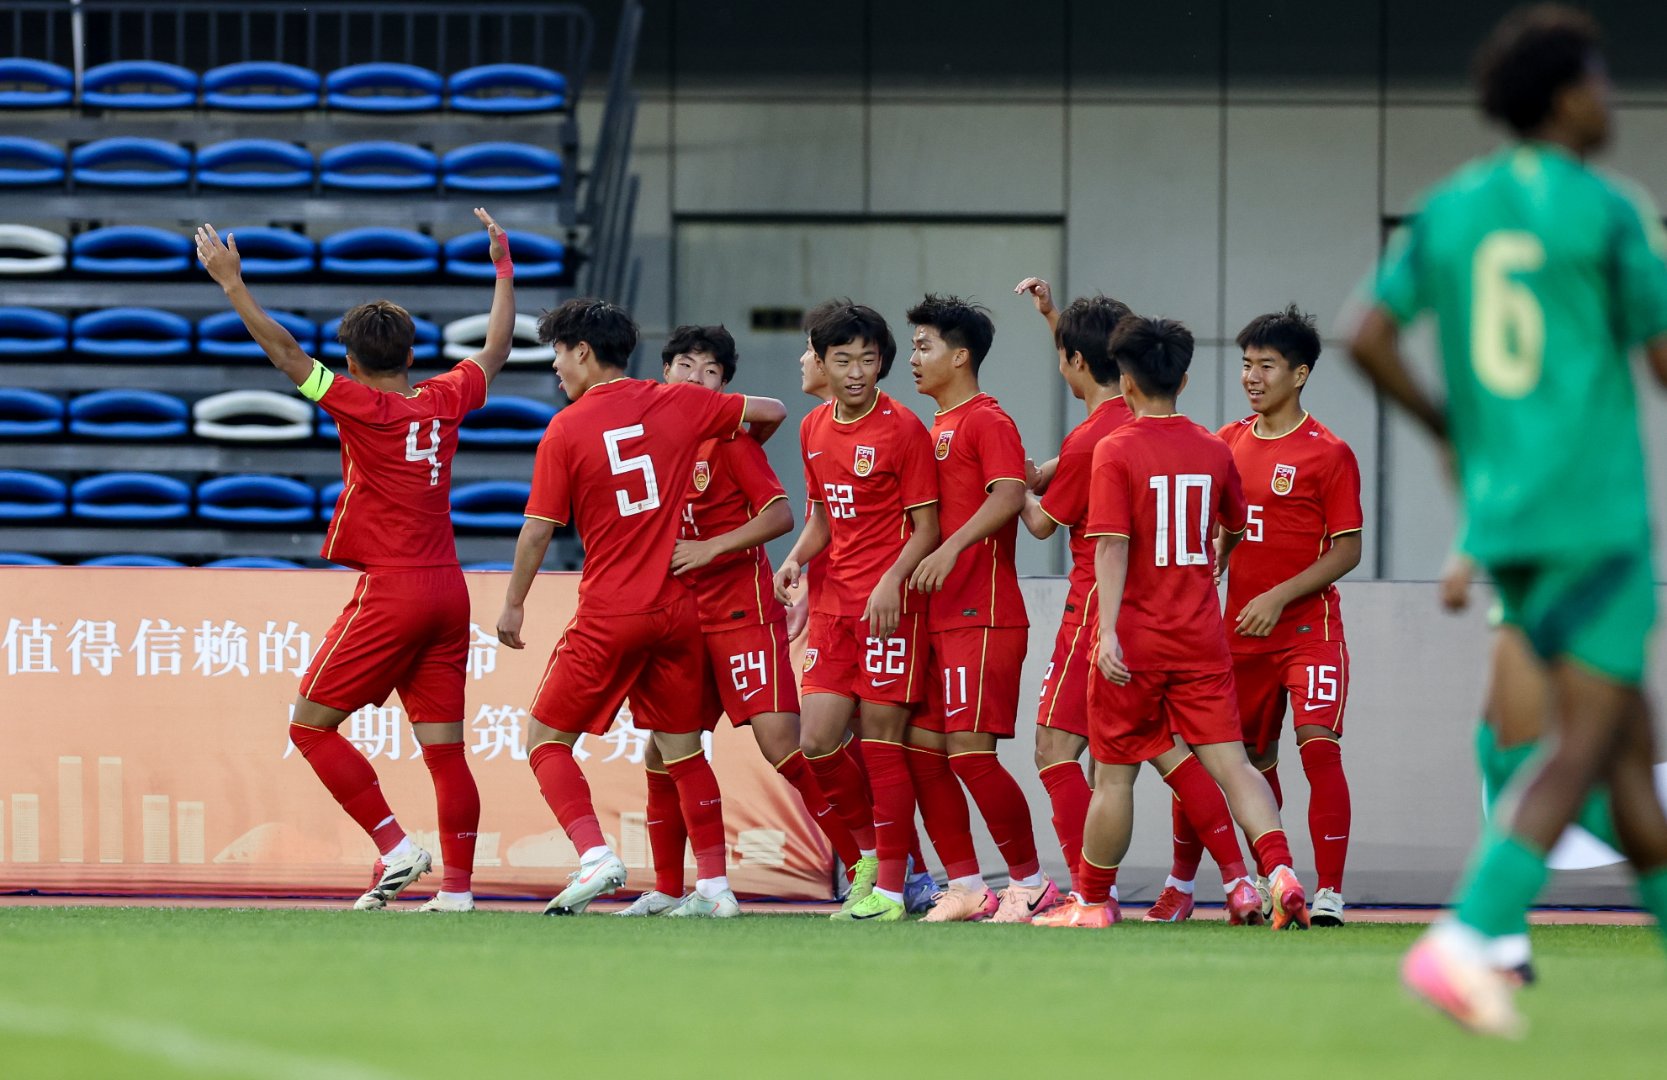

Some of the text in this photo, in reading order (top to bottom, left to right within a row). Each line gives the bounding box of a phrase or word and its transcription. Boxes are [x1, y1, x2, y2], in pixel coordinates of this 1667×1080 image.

[1469, 229, 1547, 400] 6
[405, 419, 442, 486] 4
[603, 424, 661, 517] 5
[823, 483, 857, 519] 22
[682, 503, 700, 538] 4
[1150, 474, 1212, 567] 10
[1241, 504, 1264, 542] 5
[729, 650, 767, 691] 24
[865, 637, 906, 674] 22
[944, 666, 967, 704] 11
[1306, 665, 1337, 702] 15
